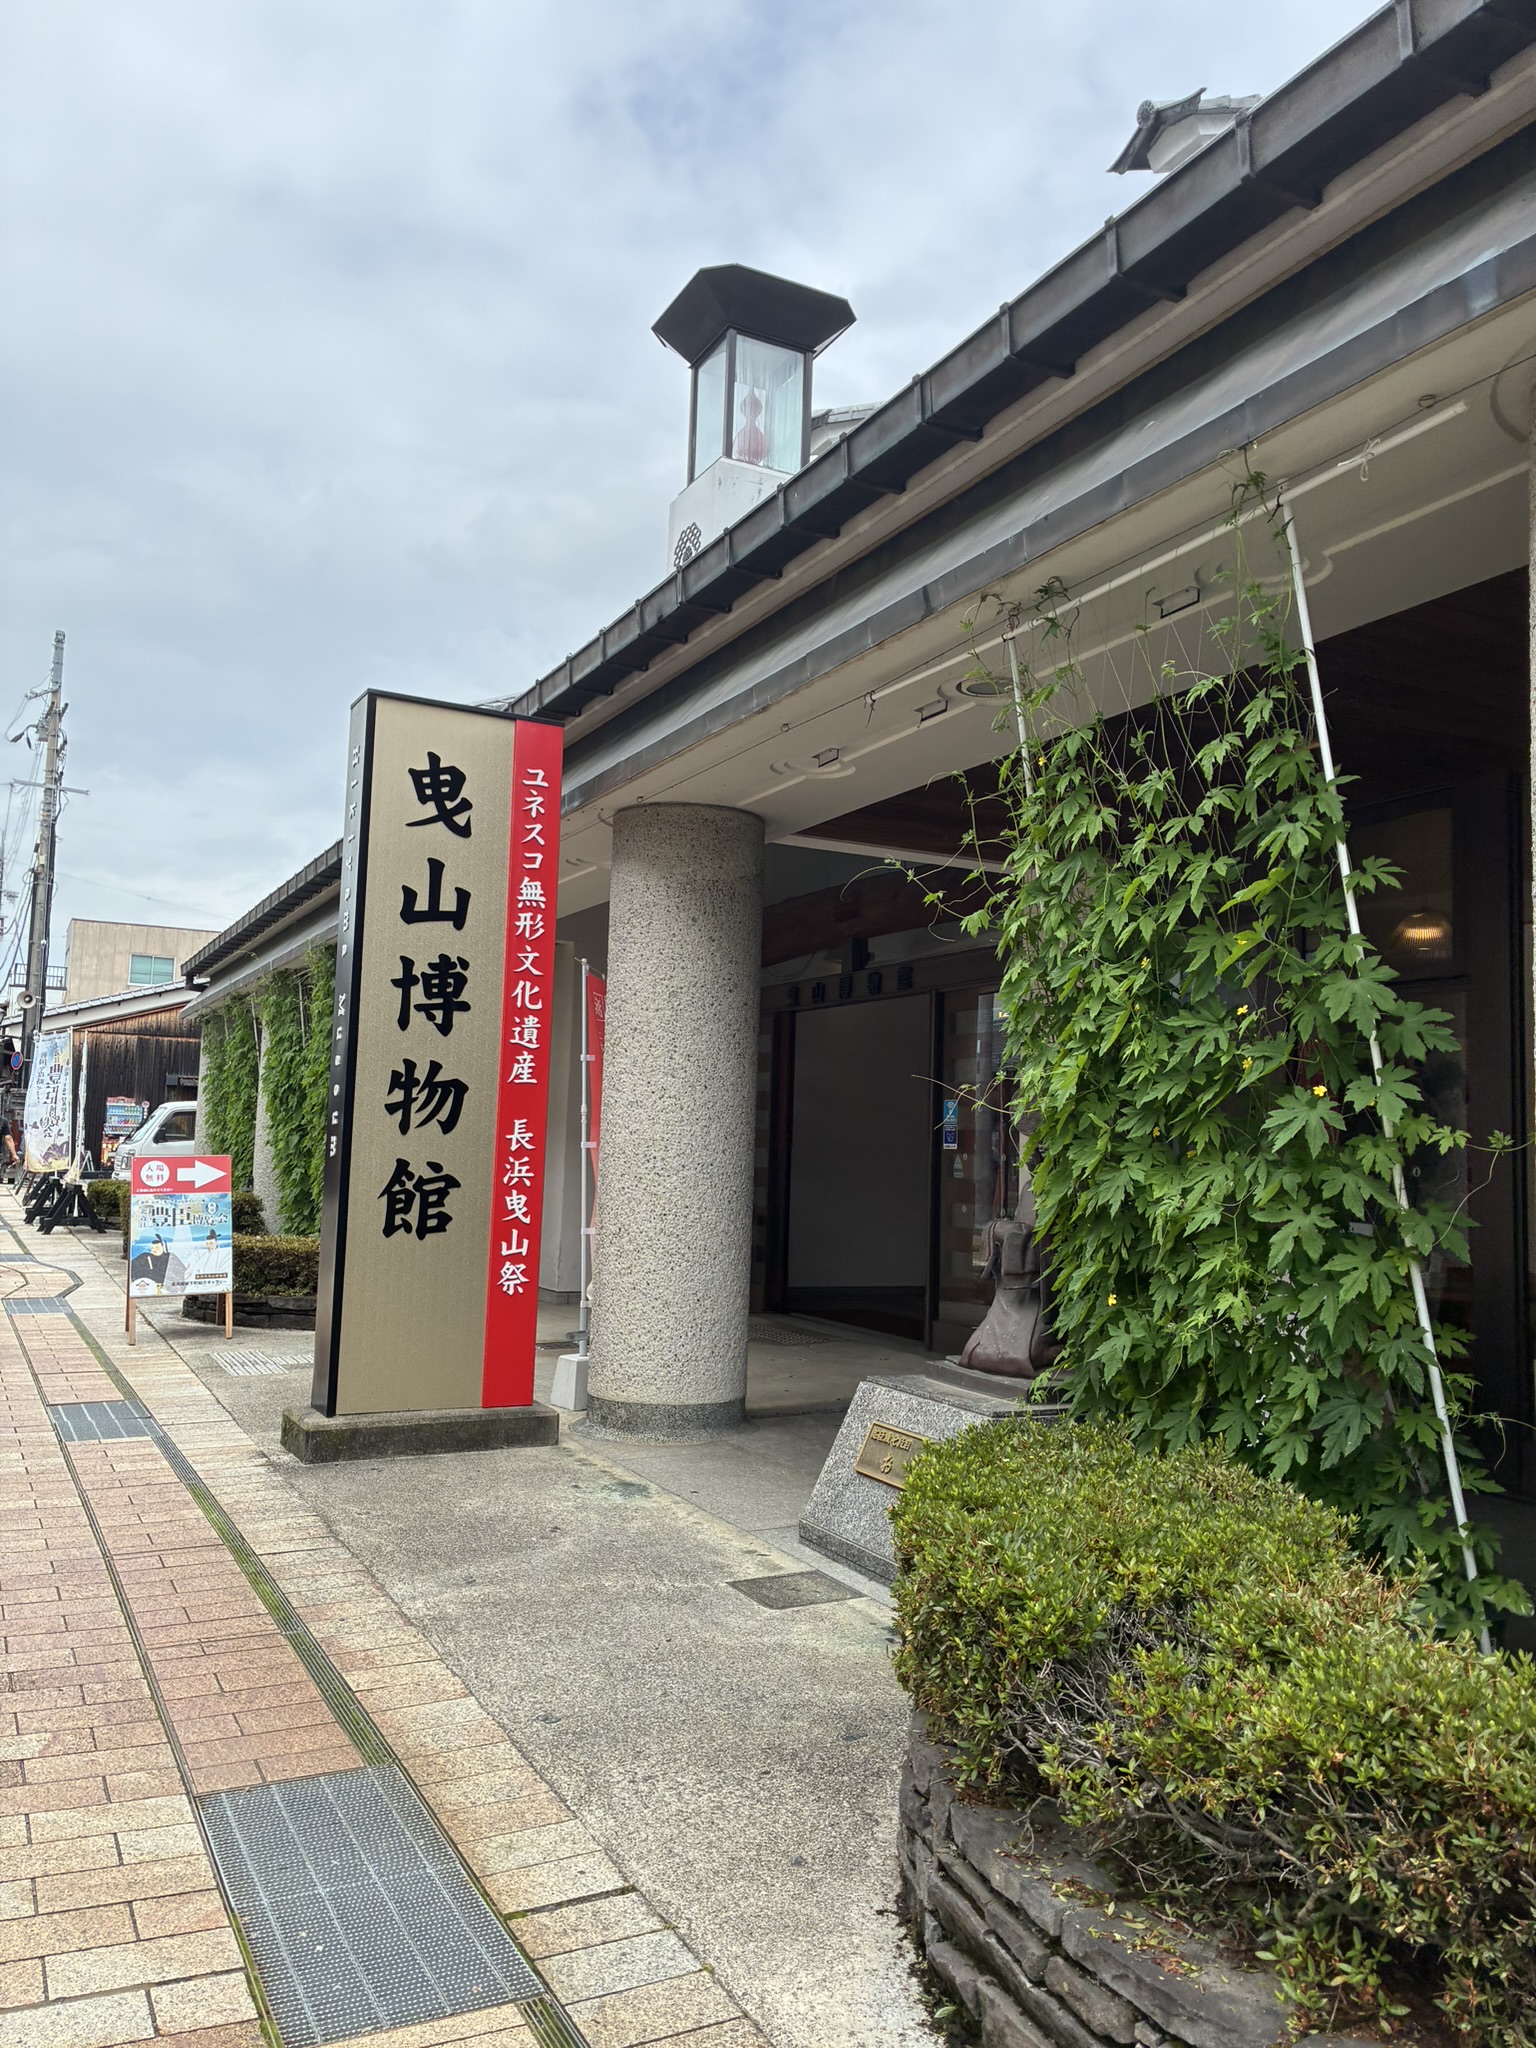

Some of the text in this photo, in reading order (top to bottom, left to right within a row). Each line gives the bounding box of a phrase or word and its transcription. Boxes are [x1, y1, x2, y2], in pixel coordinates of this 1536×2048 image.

[377, 751, 473, 1240] 曳山博物館
[497, 767, 549, 1296] ユネスコ無形文化遺産 長浜曳山祭
